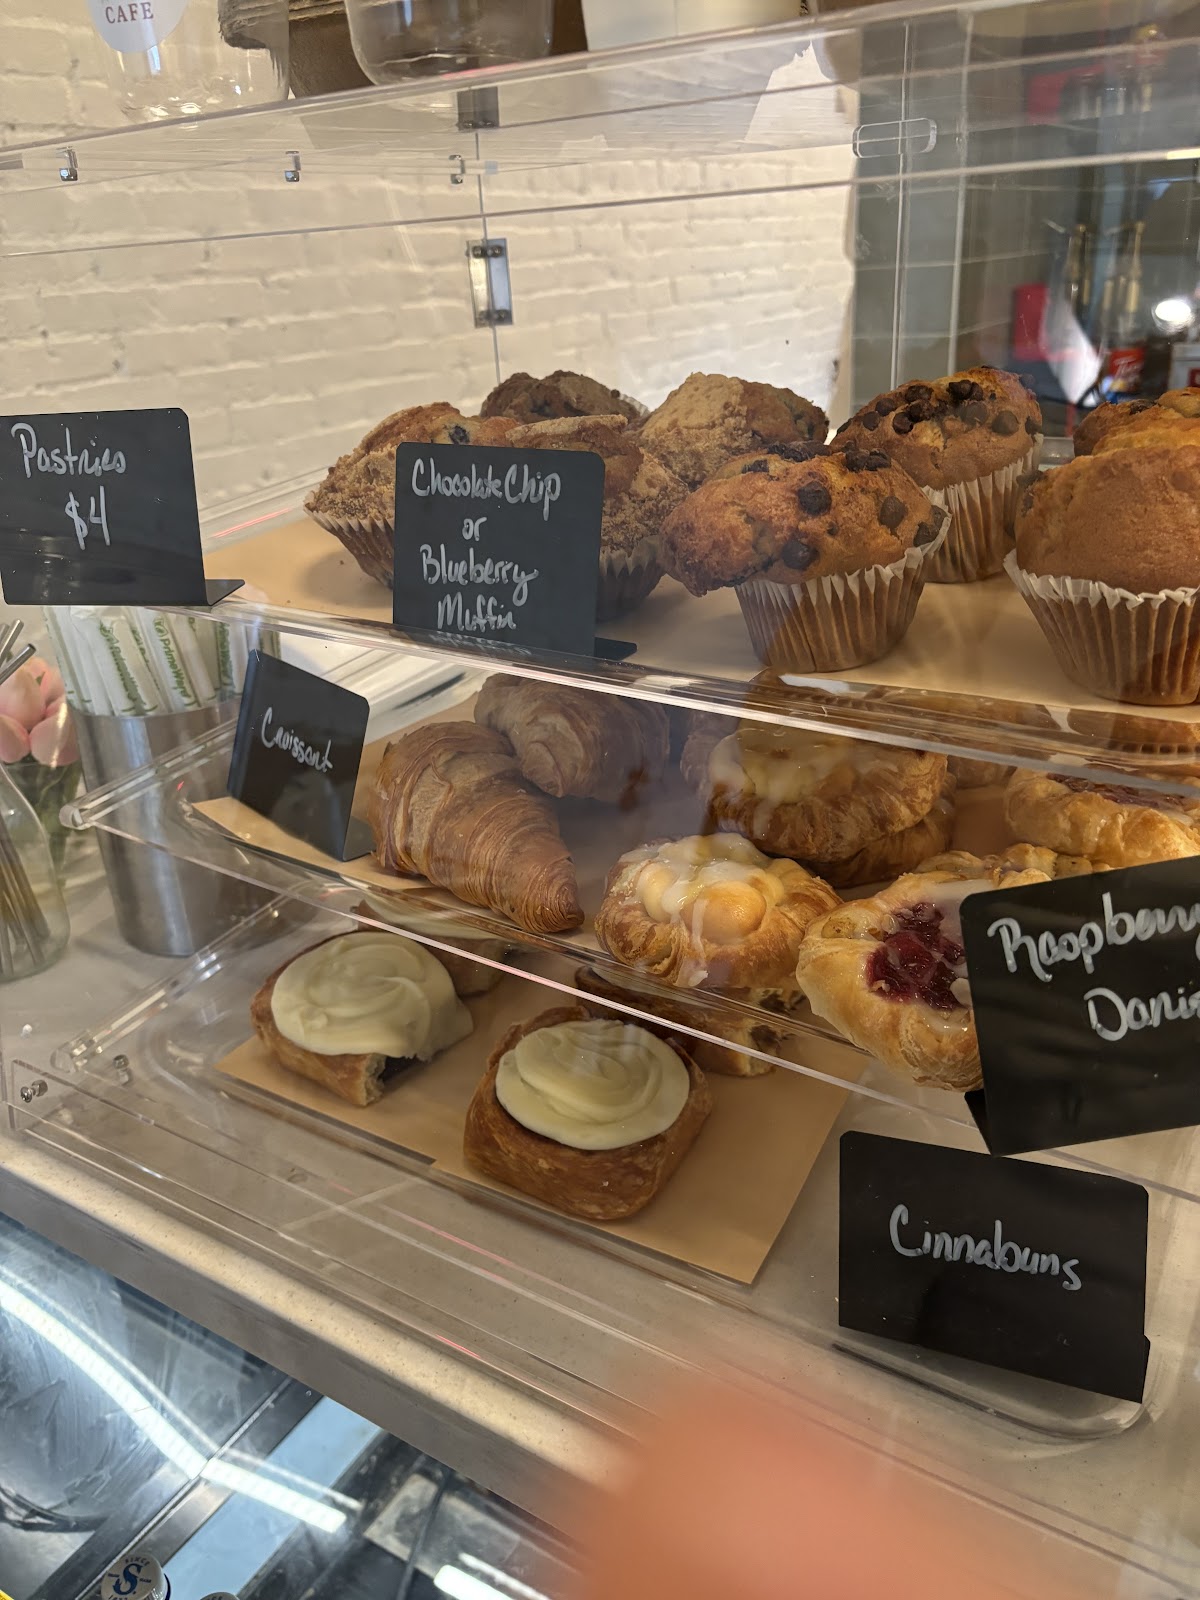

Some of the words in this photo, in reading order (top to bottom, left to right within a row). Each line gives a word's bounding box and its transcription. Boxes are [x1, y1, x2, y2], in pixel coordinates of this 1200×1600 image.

[105, 2, 154, 24] CAFE
[11, 422, 127, 478] Pastries
[64, 485, 111, 550] $4
[411, 457, 503, 499] Chocolate
[504, 463, 562, 521] Chip
[462, 516, 487, 541] or
[419, 543, 539, 607] Blueberry
[437, 592, 517, 632] Muffin
[261, 706, 334, 773] Croissant
[986, 891, 1200, 983] Raspberr
[889, 1203, 1082, 1291] Cinnabuns
